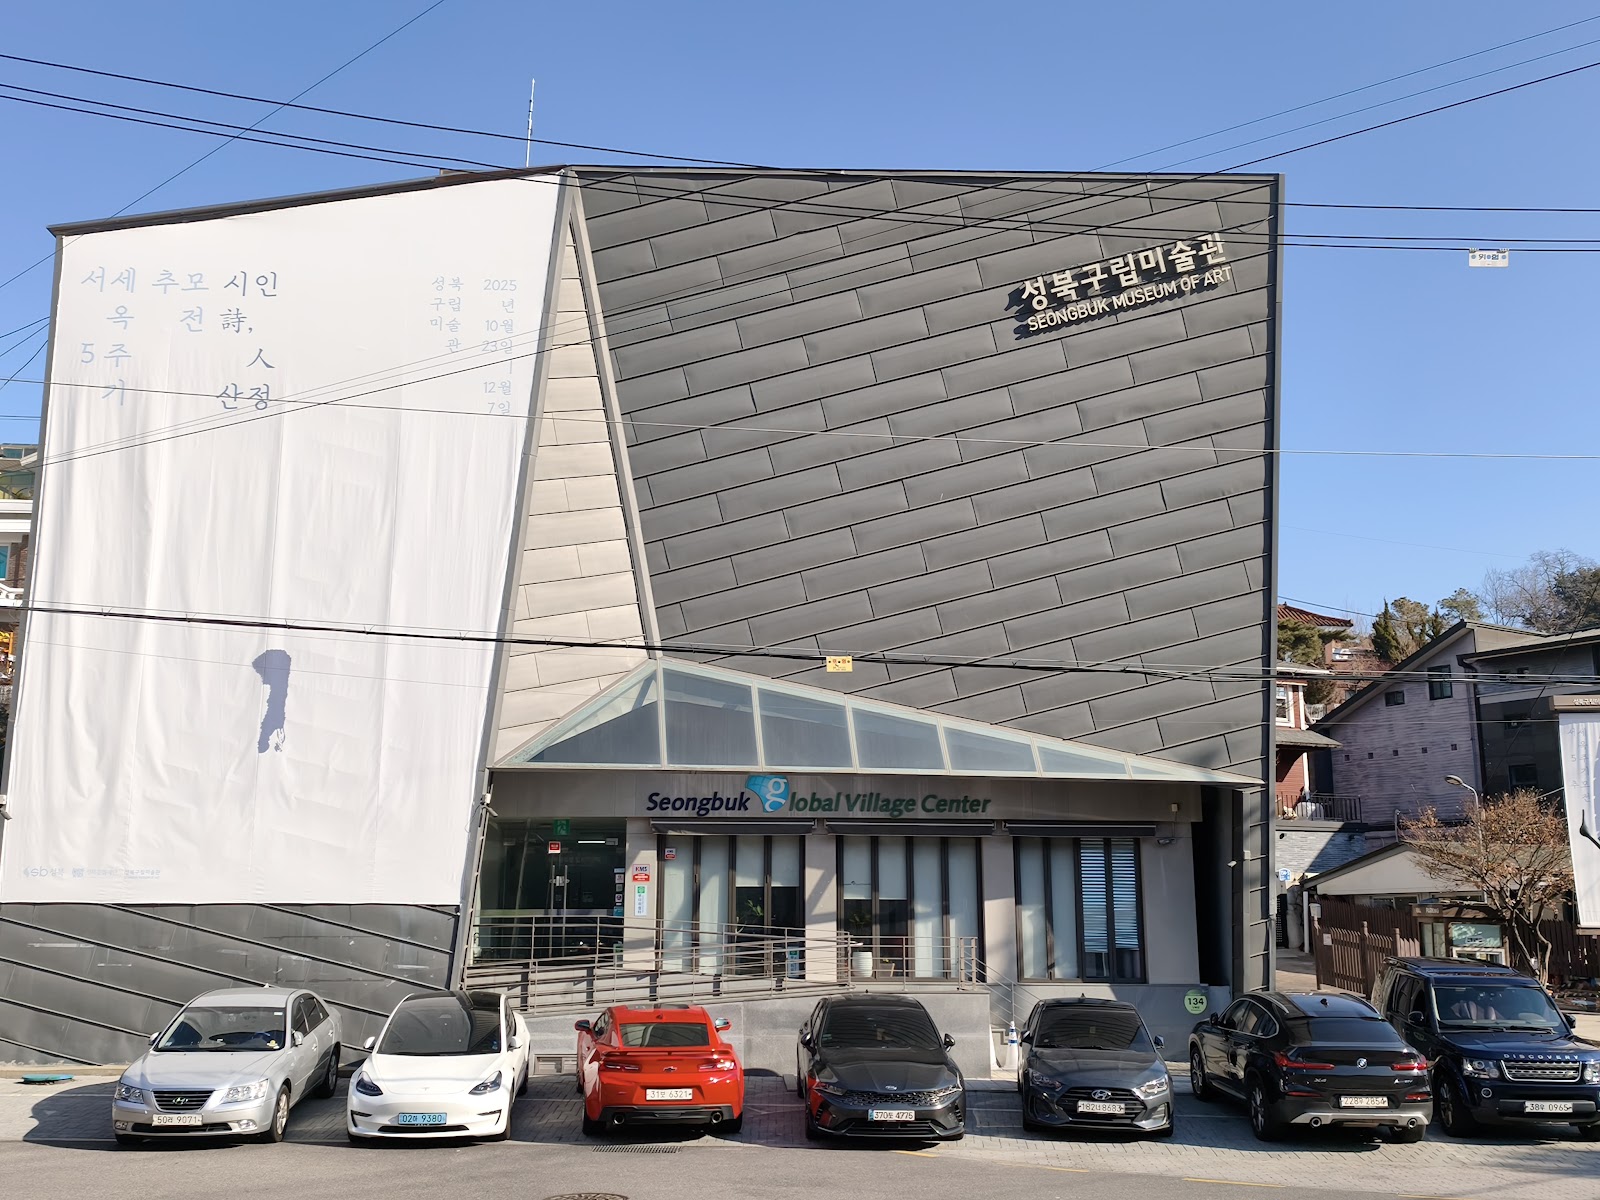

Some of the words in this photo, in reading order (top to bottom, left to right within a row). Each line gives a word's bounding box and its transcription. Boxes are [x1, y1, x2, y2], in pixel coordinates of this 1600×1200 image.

[1021, 231, 1226, 311] 성북구립미술관
[81, 266, 136, 293] 서세
[152, 269, 209, 294] 추모
[224, 271, 277, 297] 시인
[431, 276, 464, 292] 성북
[483, 279, 518, 292] 2025
[430, 297, 461, 312] 구립
[502, 298, 514, 313] 년
[1027, 297, 1110, 332] SEONGBUK
[1113, 280, 1178, 311] MUSEUM
[1181, 275, 1200, 293] OF
[1203, 265, 1232, 288] ART
[106, 305, 135, 330] 옥
[180, 306, 204, 332] 전
[430, 316, 461, 333] 미술
[485, 319, 514, 334] 10월
[445, 338, 461, 354] 관
[482, 339, 513, 355] 23일
[102, 378, 125, 406] 기
[483, 380, 511, 396] 12월
[217, 382, 270, 411] 산정
[487, 400, 510, 414] 7일
[646, 792, 750, 817] Seongbuk
[845, 793, 916, 817] Village
[921, 794, 991, 814] Center
[1188, 997, 1204, 1005] 134
[1548, 1104, 1569, 1112] 0965
[177, 1116, 197, 1124] 9071
